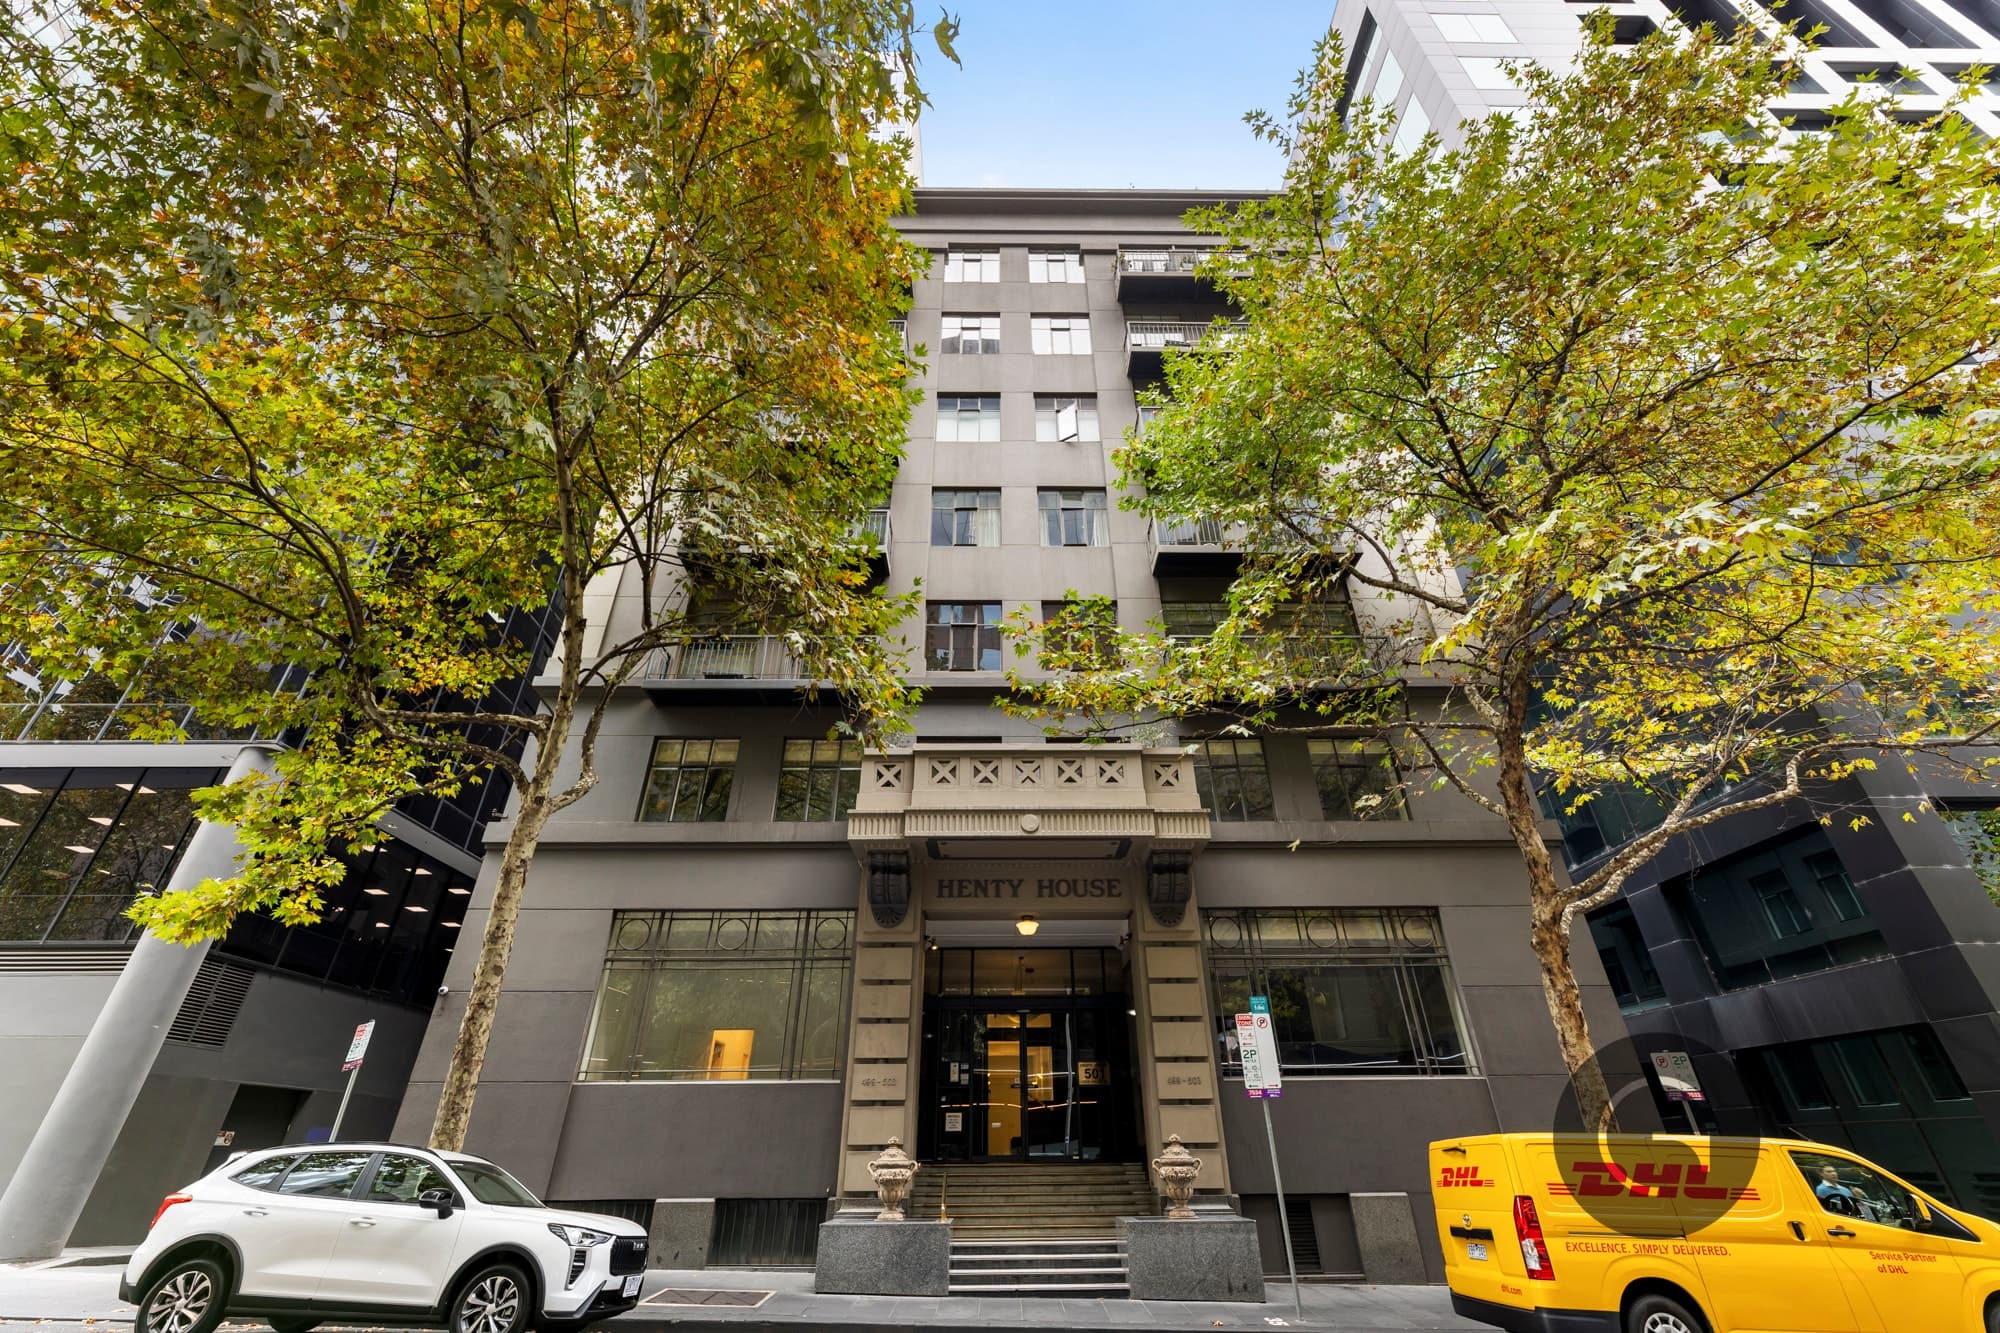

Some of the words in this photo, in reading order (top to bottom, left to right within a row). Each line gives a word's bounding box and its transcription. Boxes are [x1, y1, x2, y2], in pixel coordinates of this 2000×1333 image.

[936, 879, 1024, 898] HENTY
[1036, 878, 1122, 898] HOUSE
[1242, 1049, 1257, 1059] 2P
[1672, 1055, 1687, 1065] 2P
[1441, 1166, 1484, 1188] DHL
[1572, 1161, 1729, 1200] DHL
[1565, 1241, 1631, 1254] EXCELLENCE.
[1634, 1243, 1669, 1255] SIMPLY
[1673, 1244, 1732, 1257] DELIVERED.
[1869, 1251, 1903, 1261] Service
[1903, 1252, 1937, 1263] Partner
[1878, 1264, 1887, 1273] of
[1887, 1264, 1909, 1275] DHL
